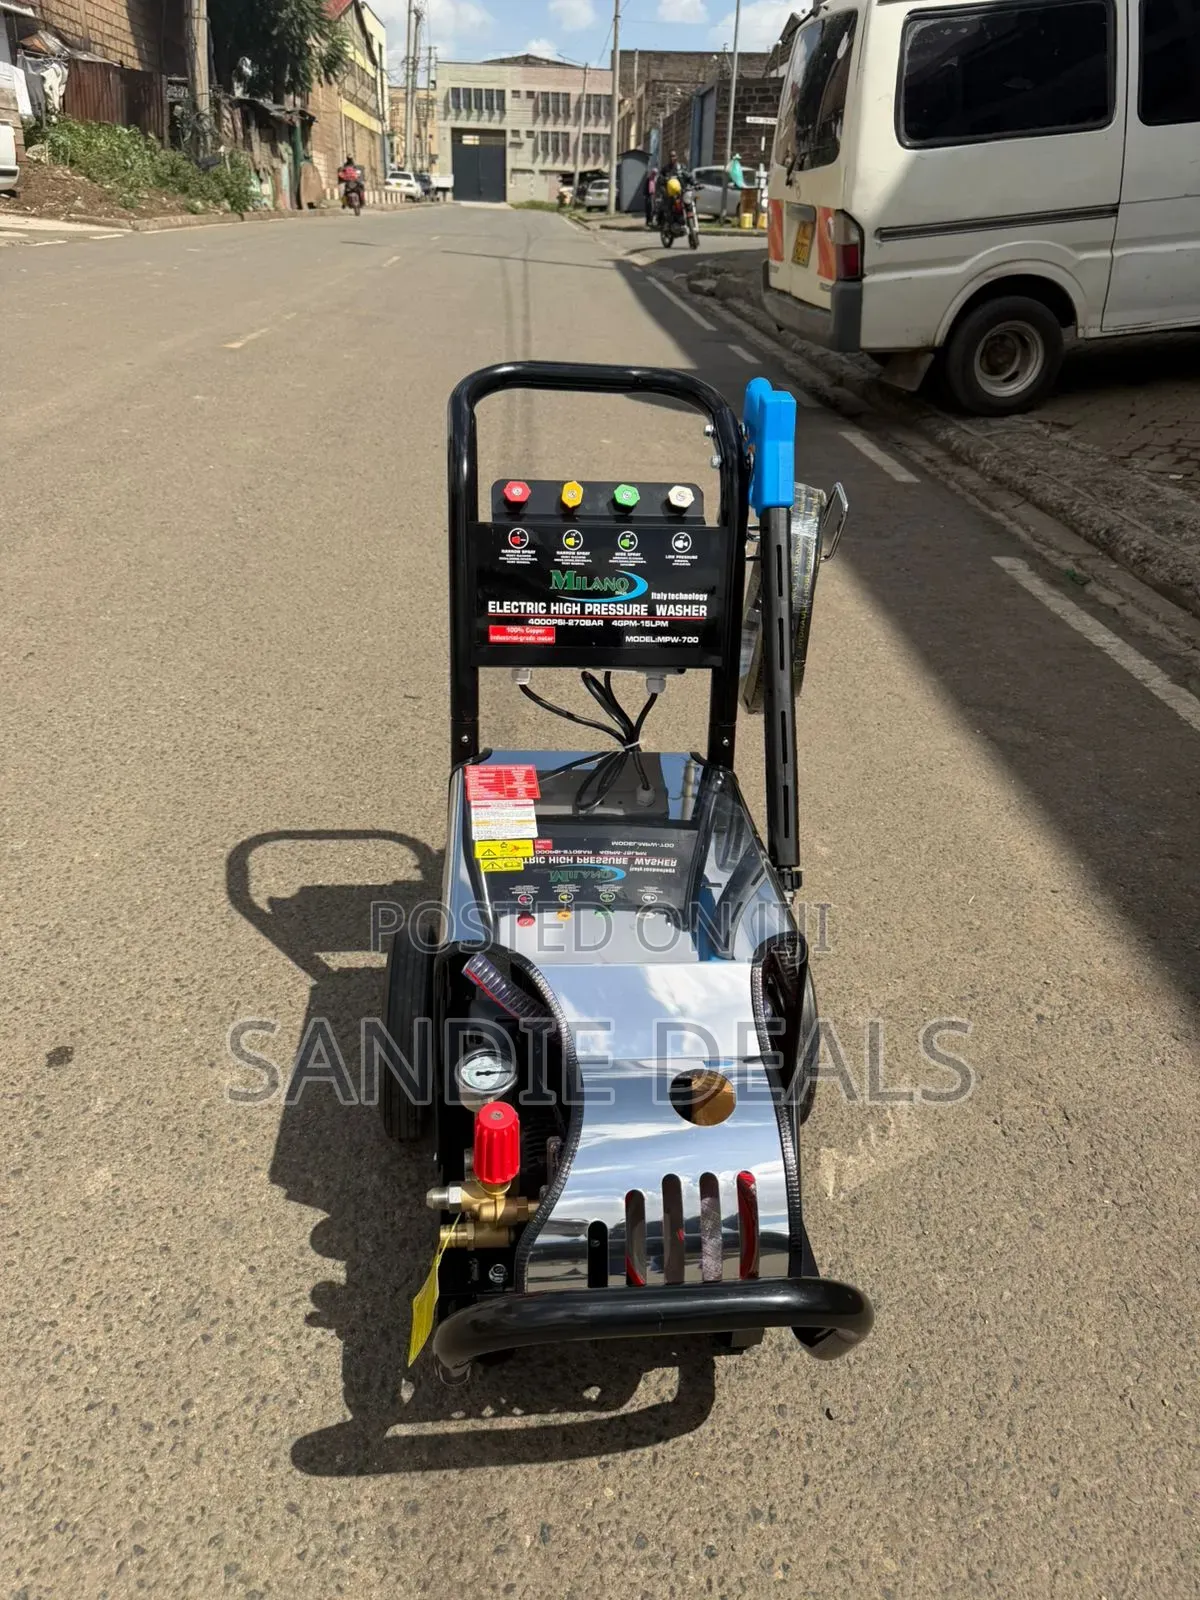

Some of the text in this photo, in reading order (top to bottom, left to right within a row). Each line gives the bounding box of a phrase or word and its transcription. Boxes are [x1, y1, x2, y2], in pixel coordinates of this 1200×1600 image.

[652, 592, 708, 602] Italy technology
[488, 601, 707, 616] ELECTRIC HIGH PRESSURE WASHER
[528, 618, 604, 626] 4000PSI-270BAR
